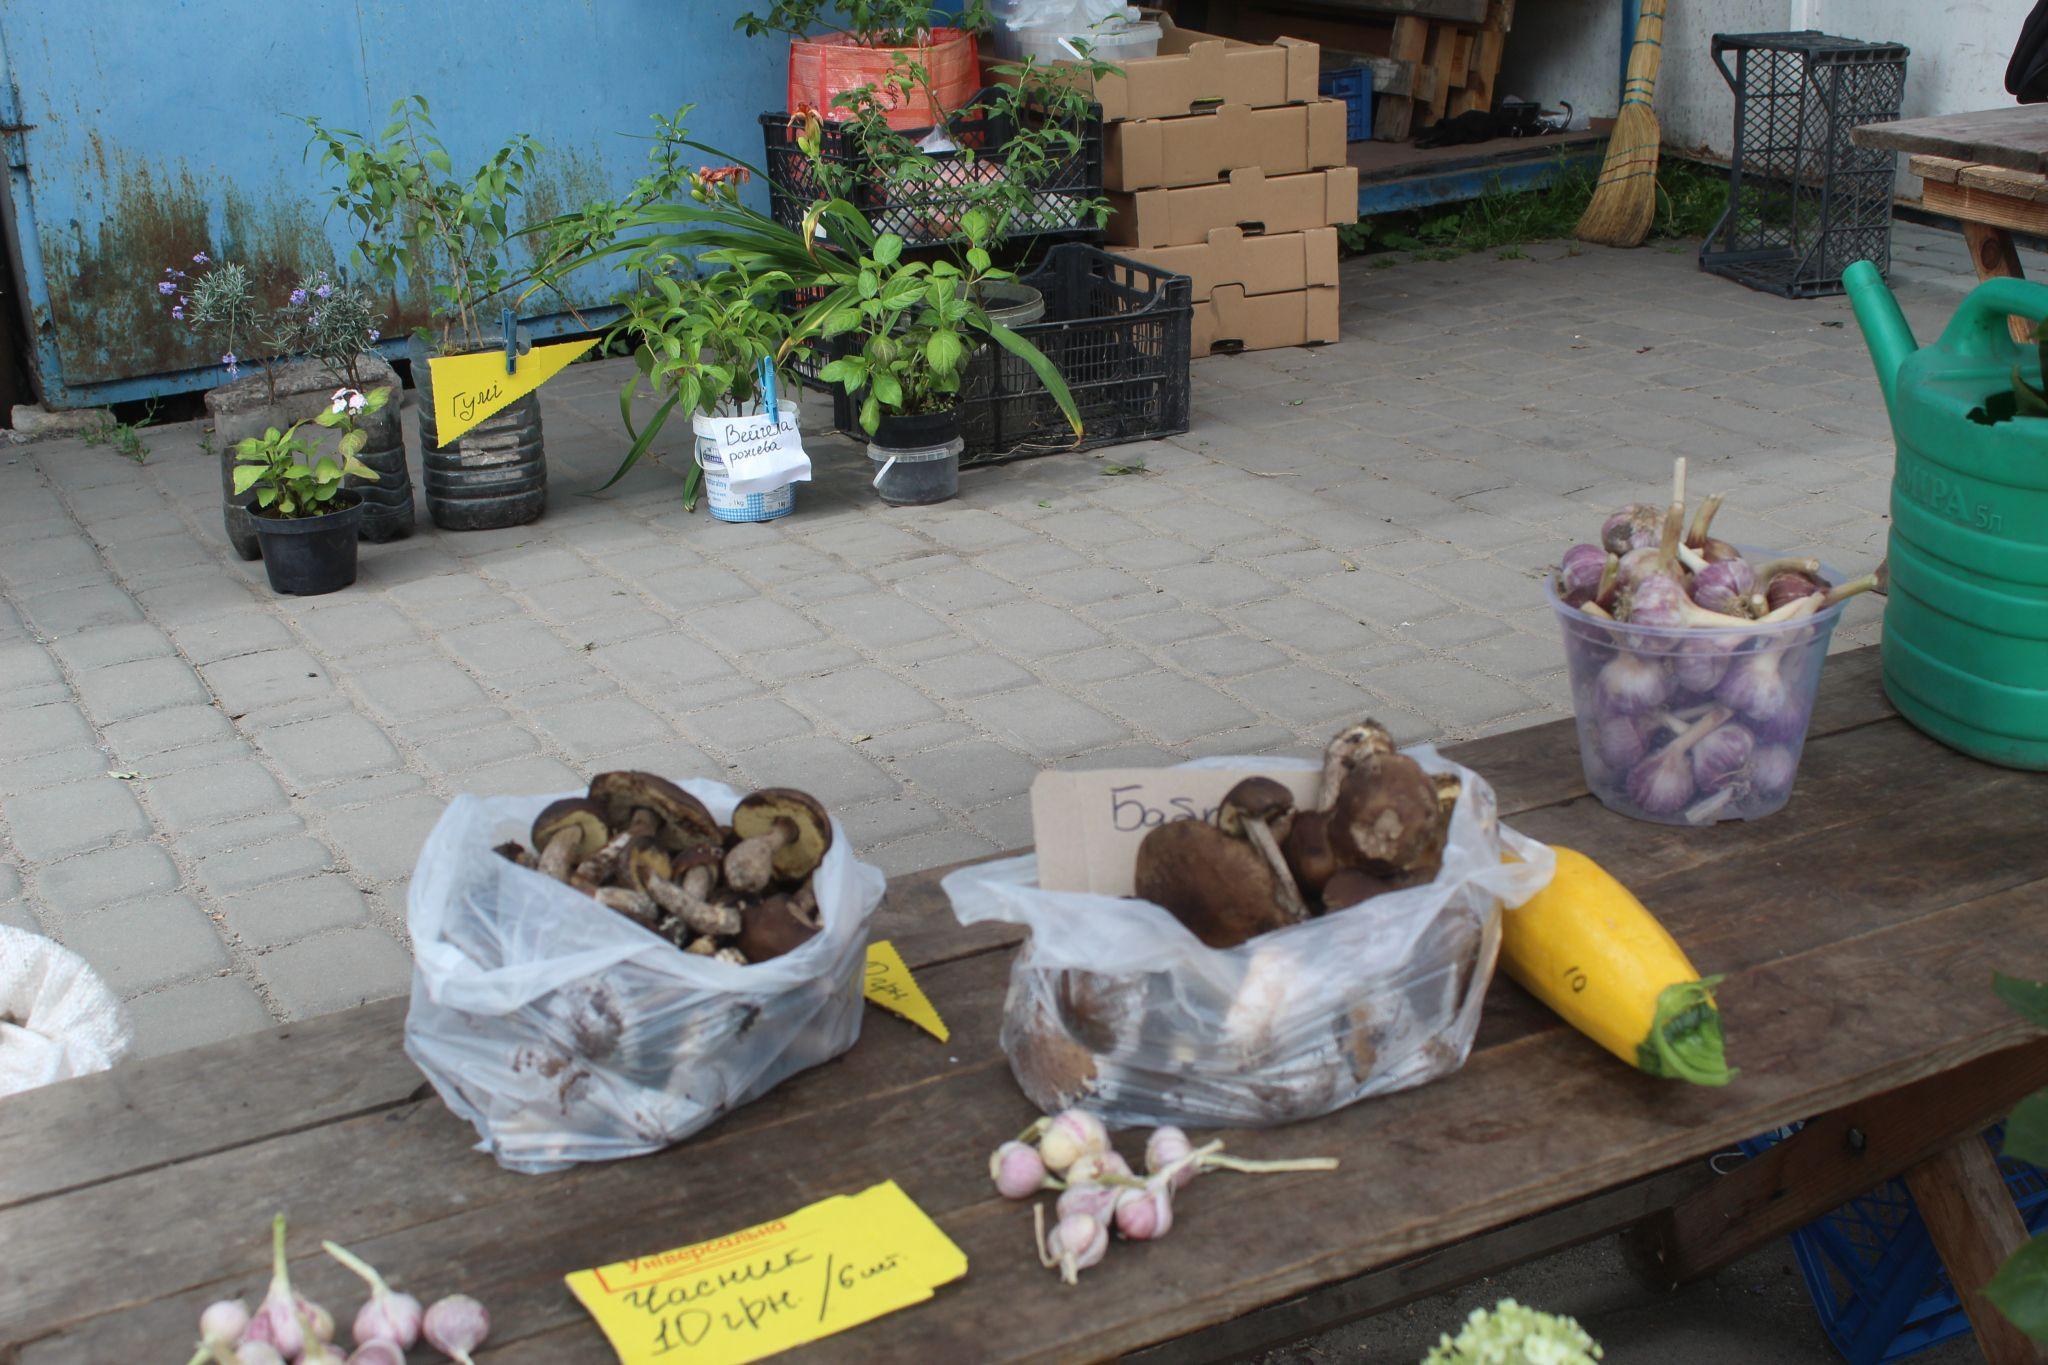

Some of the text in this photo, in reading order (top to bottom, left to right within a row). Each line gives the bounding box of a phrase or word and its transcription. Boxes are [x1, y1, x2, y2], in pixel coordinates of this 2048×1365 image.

[453, 380, 502, 421] Гумі
[725, 421, 793, 446] Вейгела
[729, 440, 782, 468] рожева
